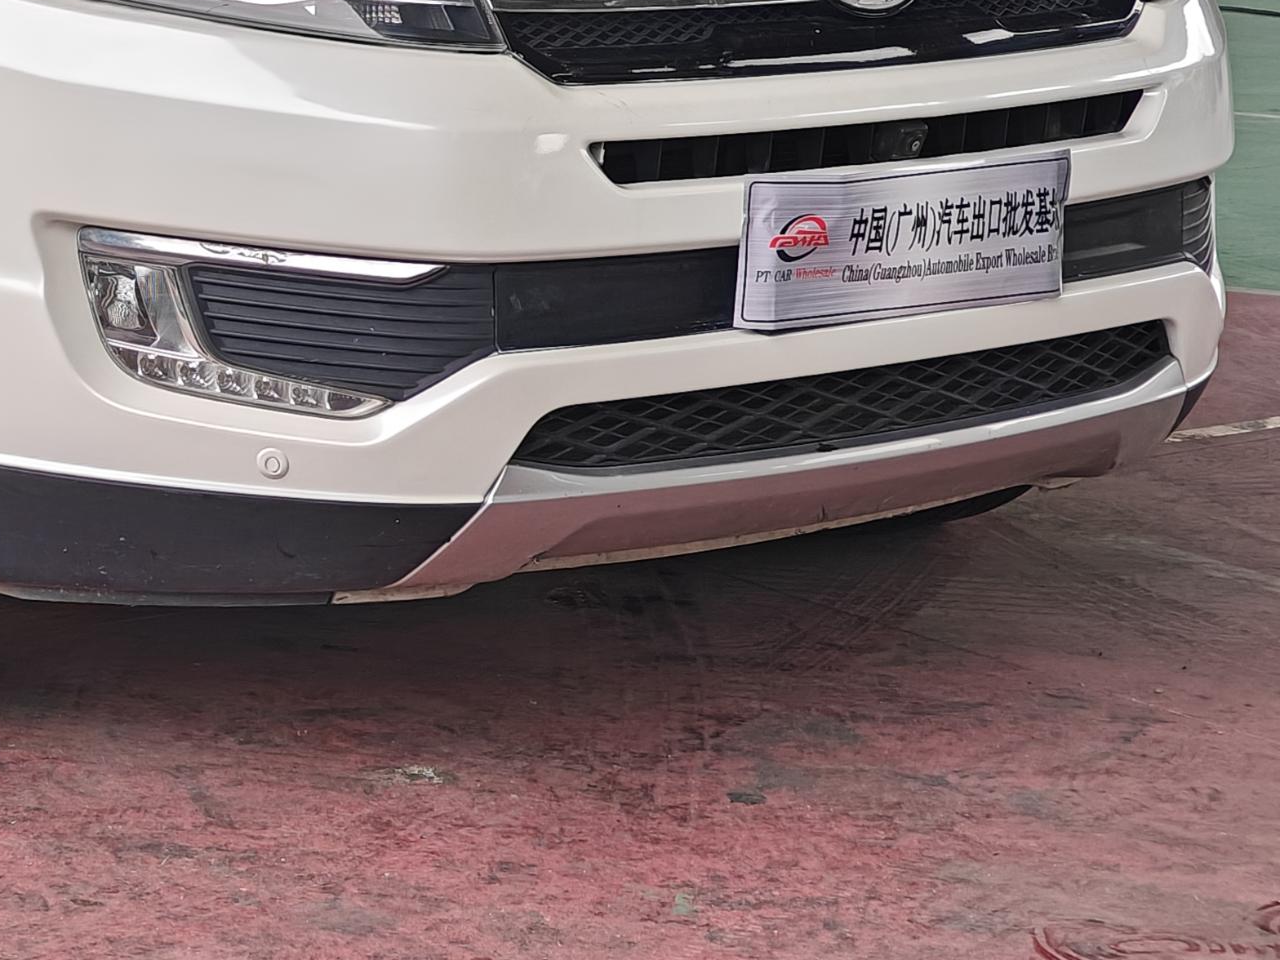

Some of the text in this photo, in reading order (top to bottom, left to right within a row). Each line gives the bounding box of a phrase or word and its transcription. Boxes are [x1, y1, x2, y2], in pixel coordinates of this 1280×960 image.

[975, 248, 1004, 274] Export
[1005, 245, 1047, 267] Wholesale
[755, 270, 771, 283] PT
[774, 268, 793, 282] CAR
